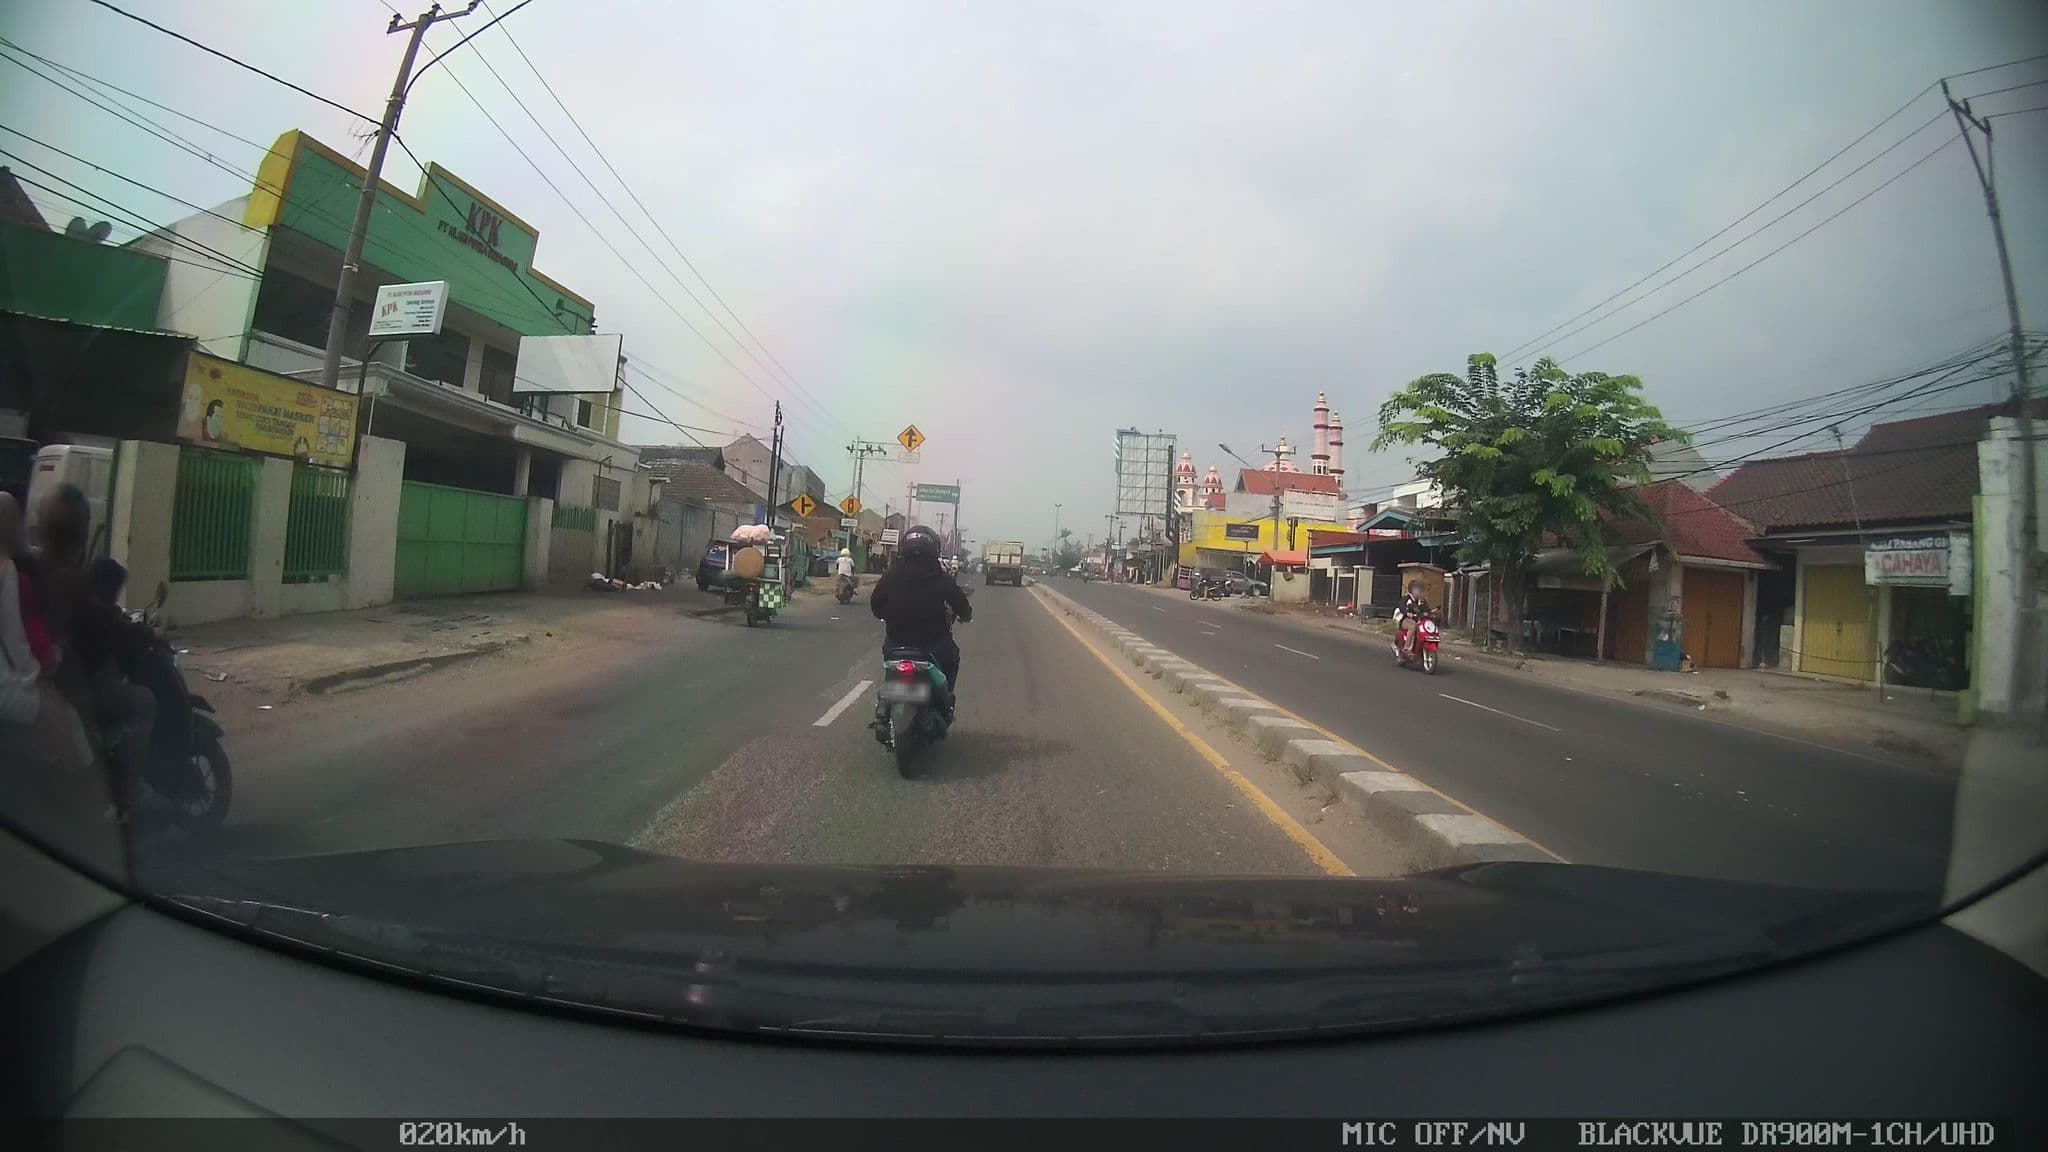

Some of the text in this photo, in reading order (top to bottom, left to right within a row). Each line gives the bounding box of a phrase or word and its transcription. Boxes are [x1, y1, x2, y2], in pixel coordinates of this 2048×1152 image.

[467, 202, 502, 247] KPK
[381, 302, 398, 318] KPK
[1882, 552, 1941, 574] CAHAYA
